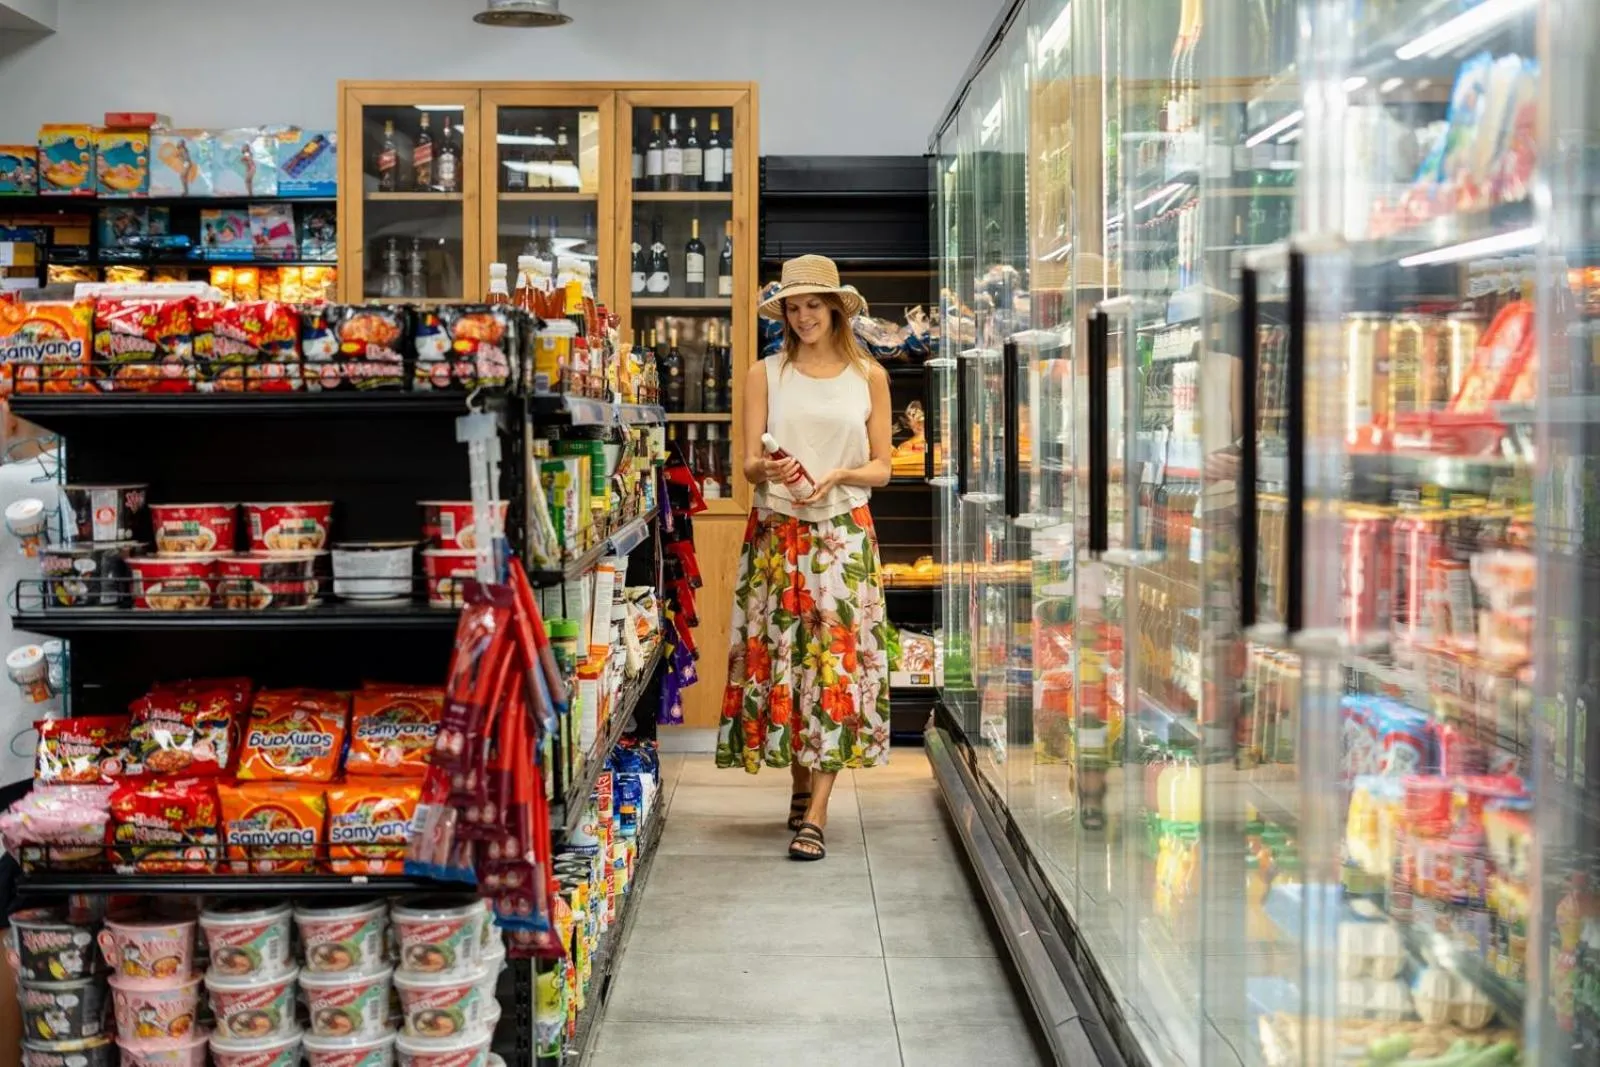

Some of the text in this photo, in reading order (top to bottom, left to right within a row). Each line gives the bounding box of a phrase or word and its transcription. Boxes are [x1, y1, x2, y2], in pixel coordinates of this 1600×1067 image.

[358, 723, 441, 737] samyang
[249, 731, 333, 747] samyang
[230, 829, 314, 847] samyang
